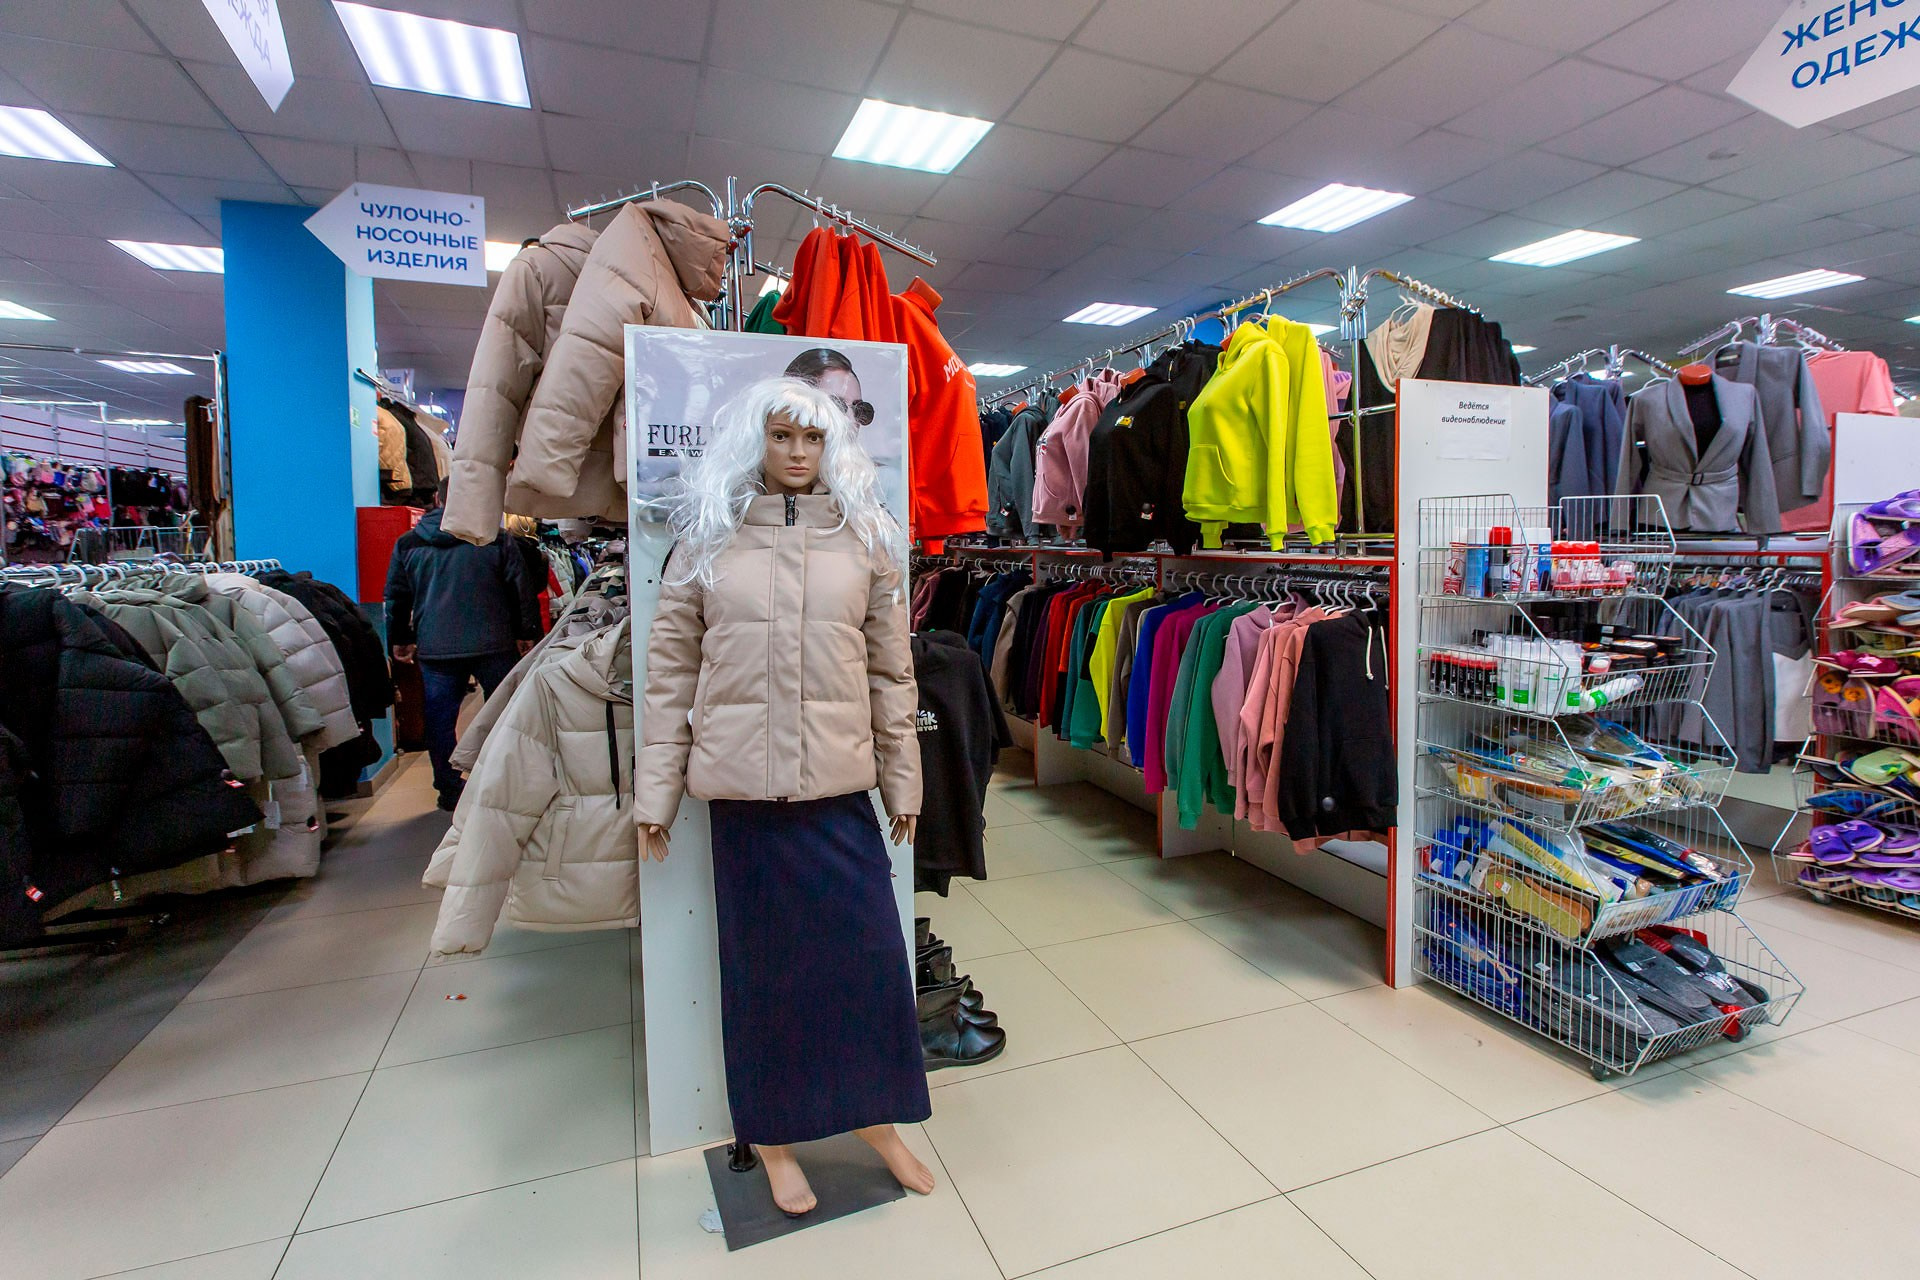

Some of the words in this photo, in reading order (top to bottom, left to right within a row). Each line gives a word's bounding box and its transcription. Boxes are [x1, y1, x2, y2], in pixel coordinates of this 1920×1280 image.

[1791, 15, 1920, 89] ОДЕЖ
[360, 202, 471, 227] ЧУЛОЧНО-
[356, 225, 479, 250] НОСОЧНЫЕ
[367, 249, 468, 271] ИЗДЕЛИЯ
[1458, 401, 1490, 411] Ведётся
[1441, 414, 1507, 425] видеонаблюдение
[647, 424, 711, 447] FURL
